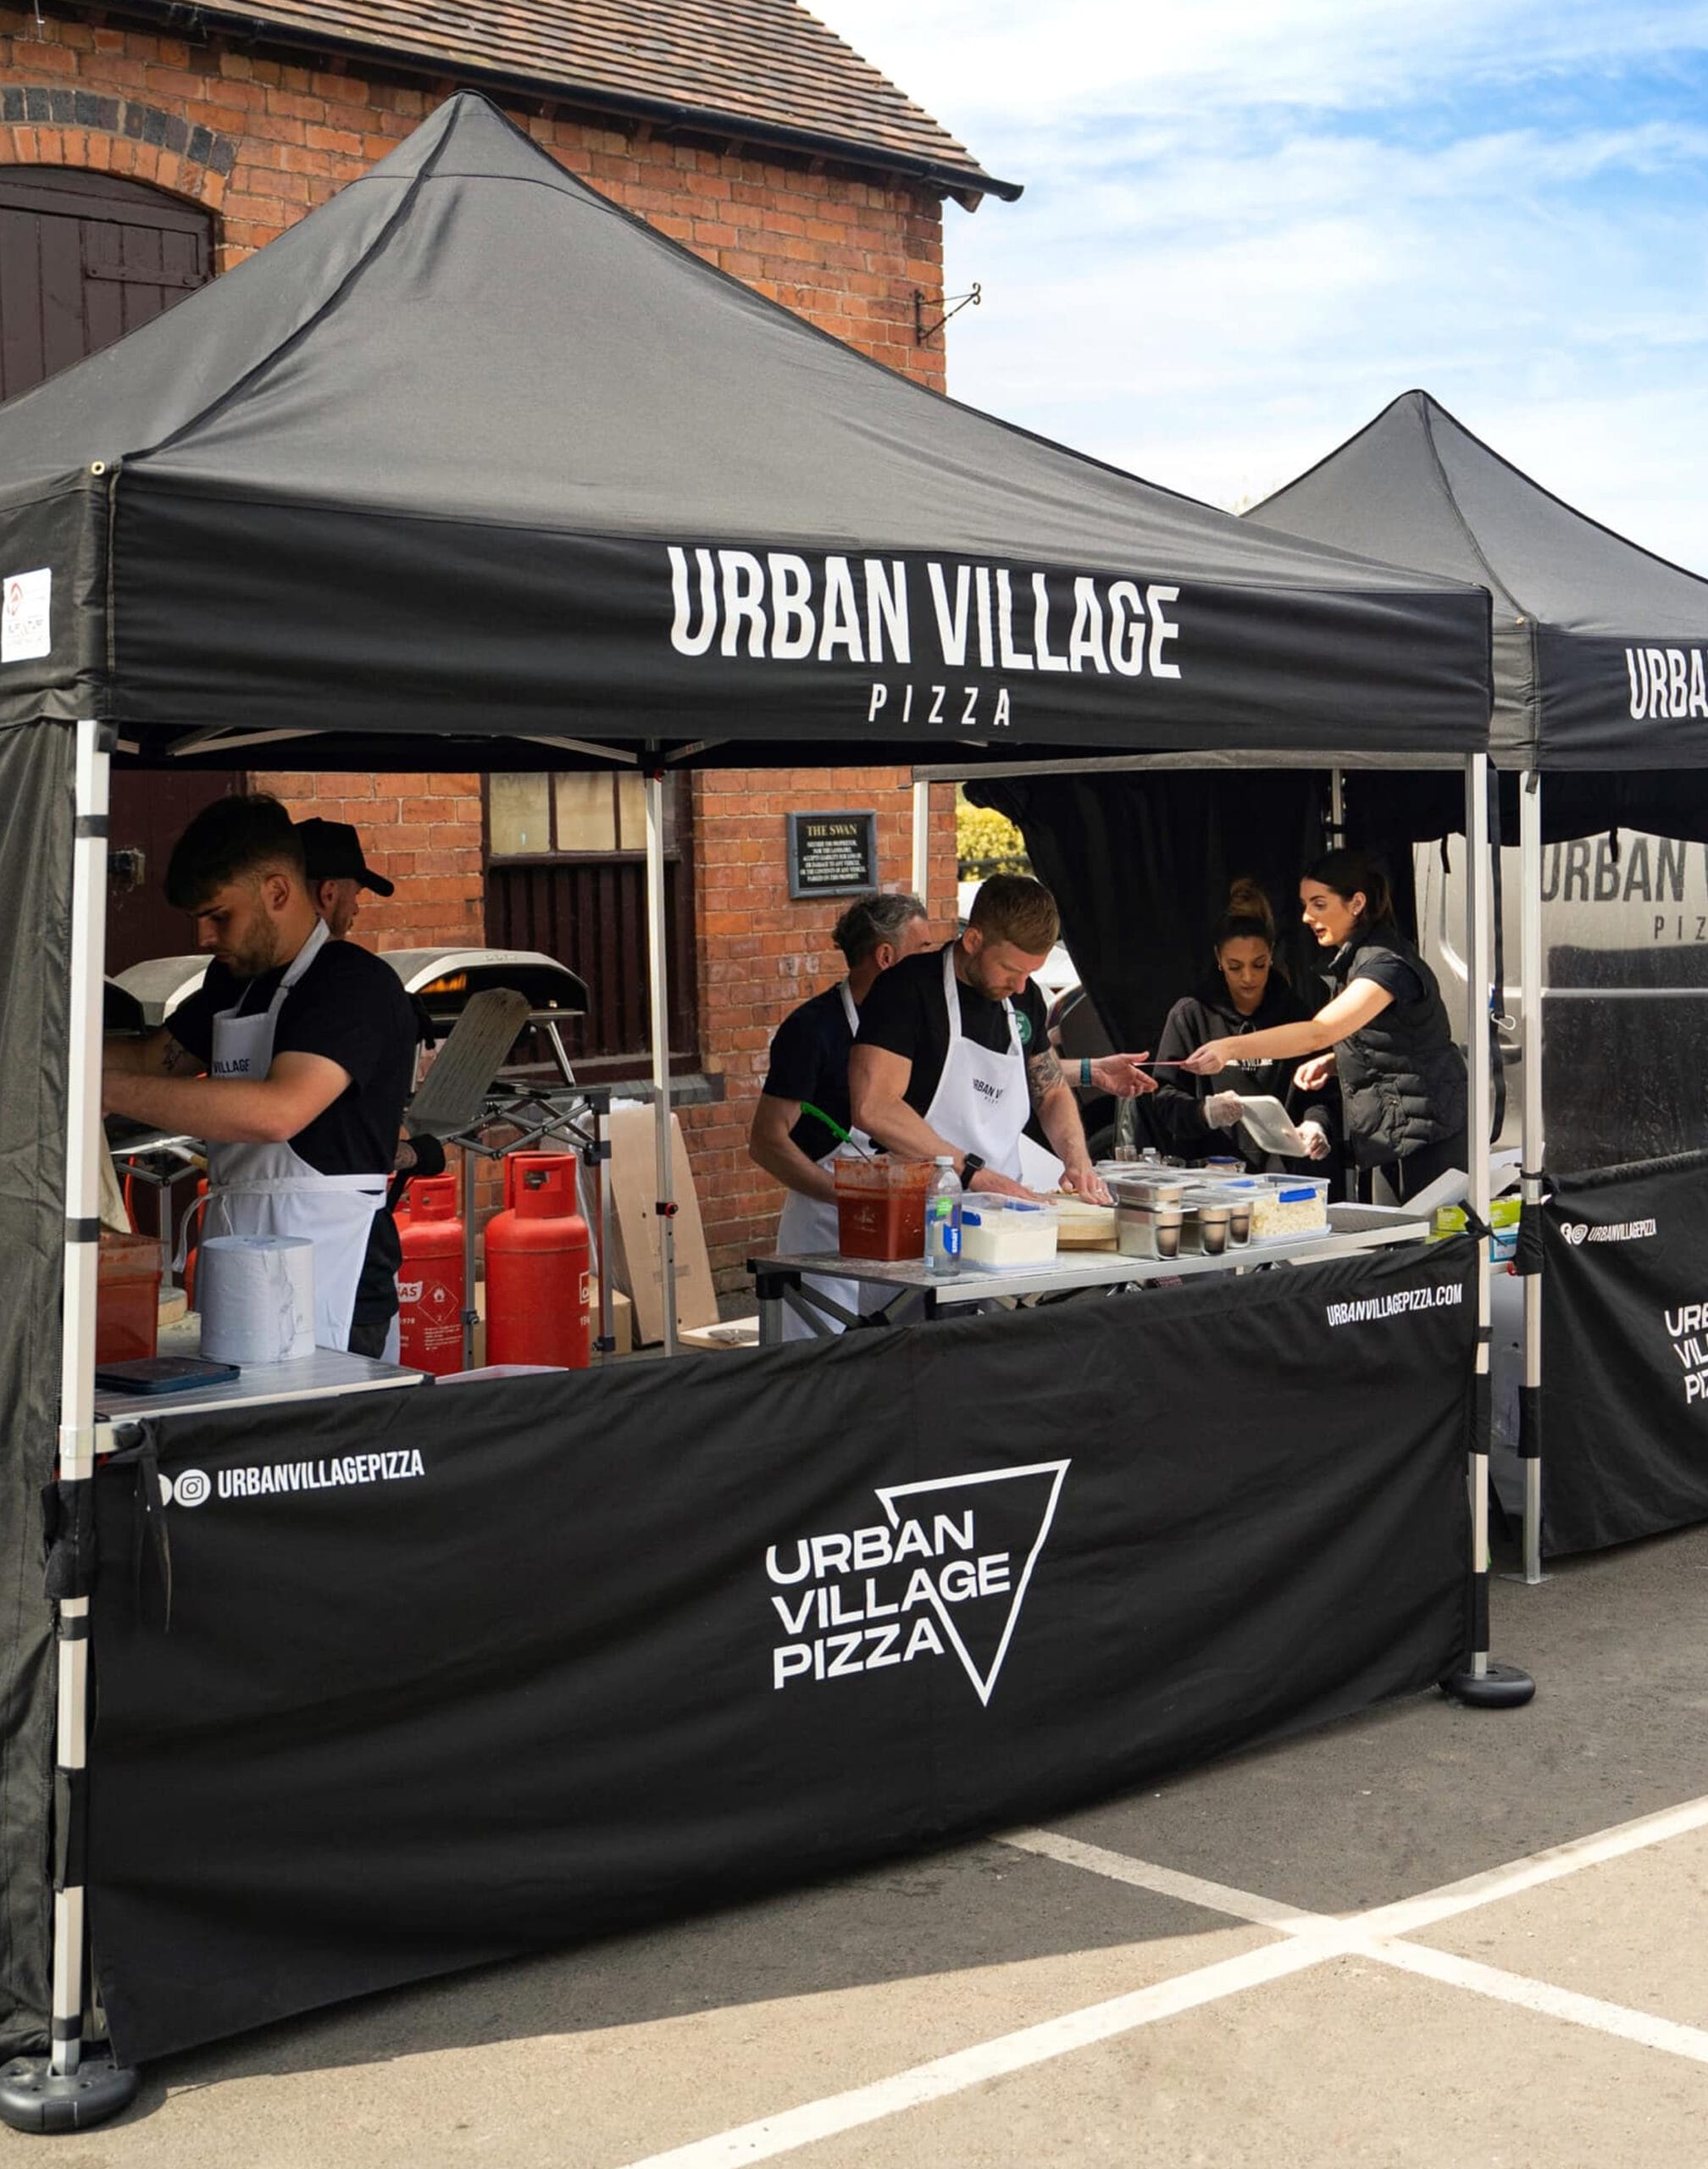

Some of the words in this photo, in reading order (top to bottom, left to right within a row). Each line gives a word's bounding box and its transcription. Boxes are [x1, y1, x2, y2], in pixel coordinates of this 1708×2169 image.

[667, 546, 912, 663] URBAN
[927, 562, 1183, 680] VILLAGE
[868, 683, 1010, 726] PIZZA
[807, 825, 828, 836] THE
[829, 824, 858, 835] SWAN
[1540, 837, 1687, 901] URBAN
[1654, 916, 1707, 940] PIZ
[1588, 1218, 1657, 1241] URBANVILLAGEPIZZA
[1327, 1283, 1462, 1327] URBANVILLAGEPIZZA.COM
[1673, 1333, 1708, 1368] VIL
[219, 1449, 424, 1498] URBANVILLAGEPIZZA
[766, 1510, 976, 1584] URBAN
[771, 1552, 1011, 1634] VILLAGE
[773, 1617, 946, 1690] PIZZA
